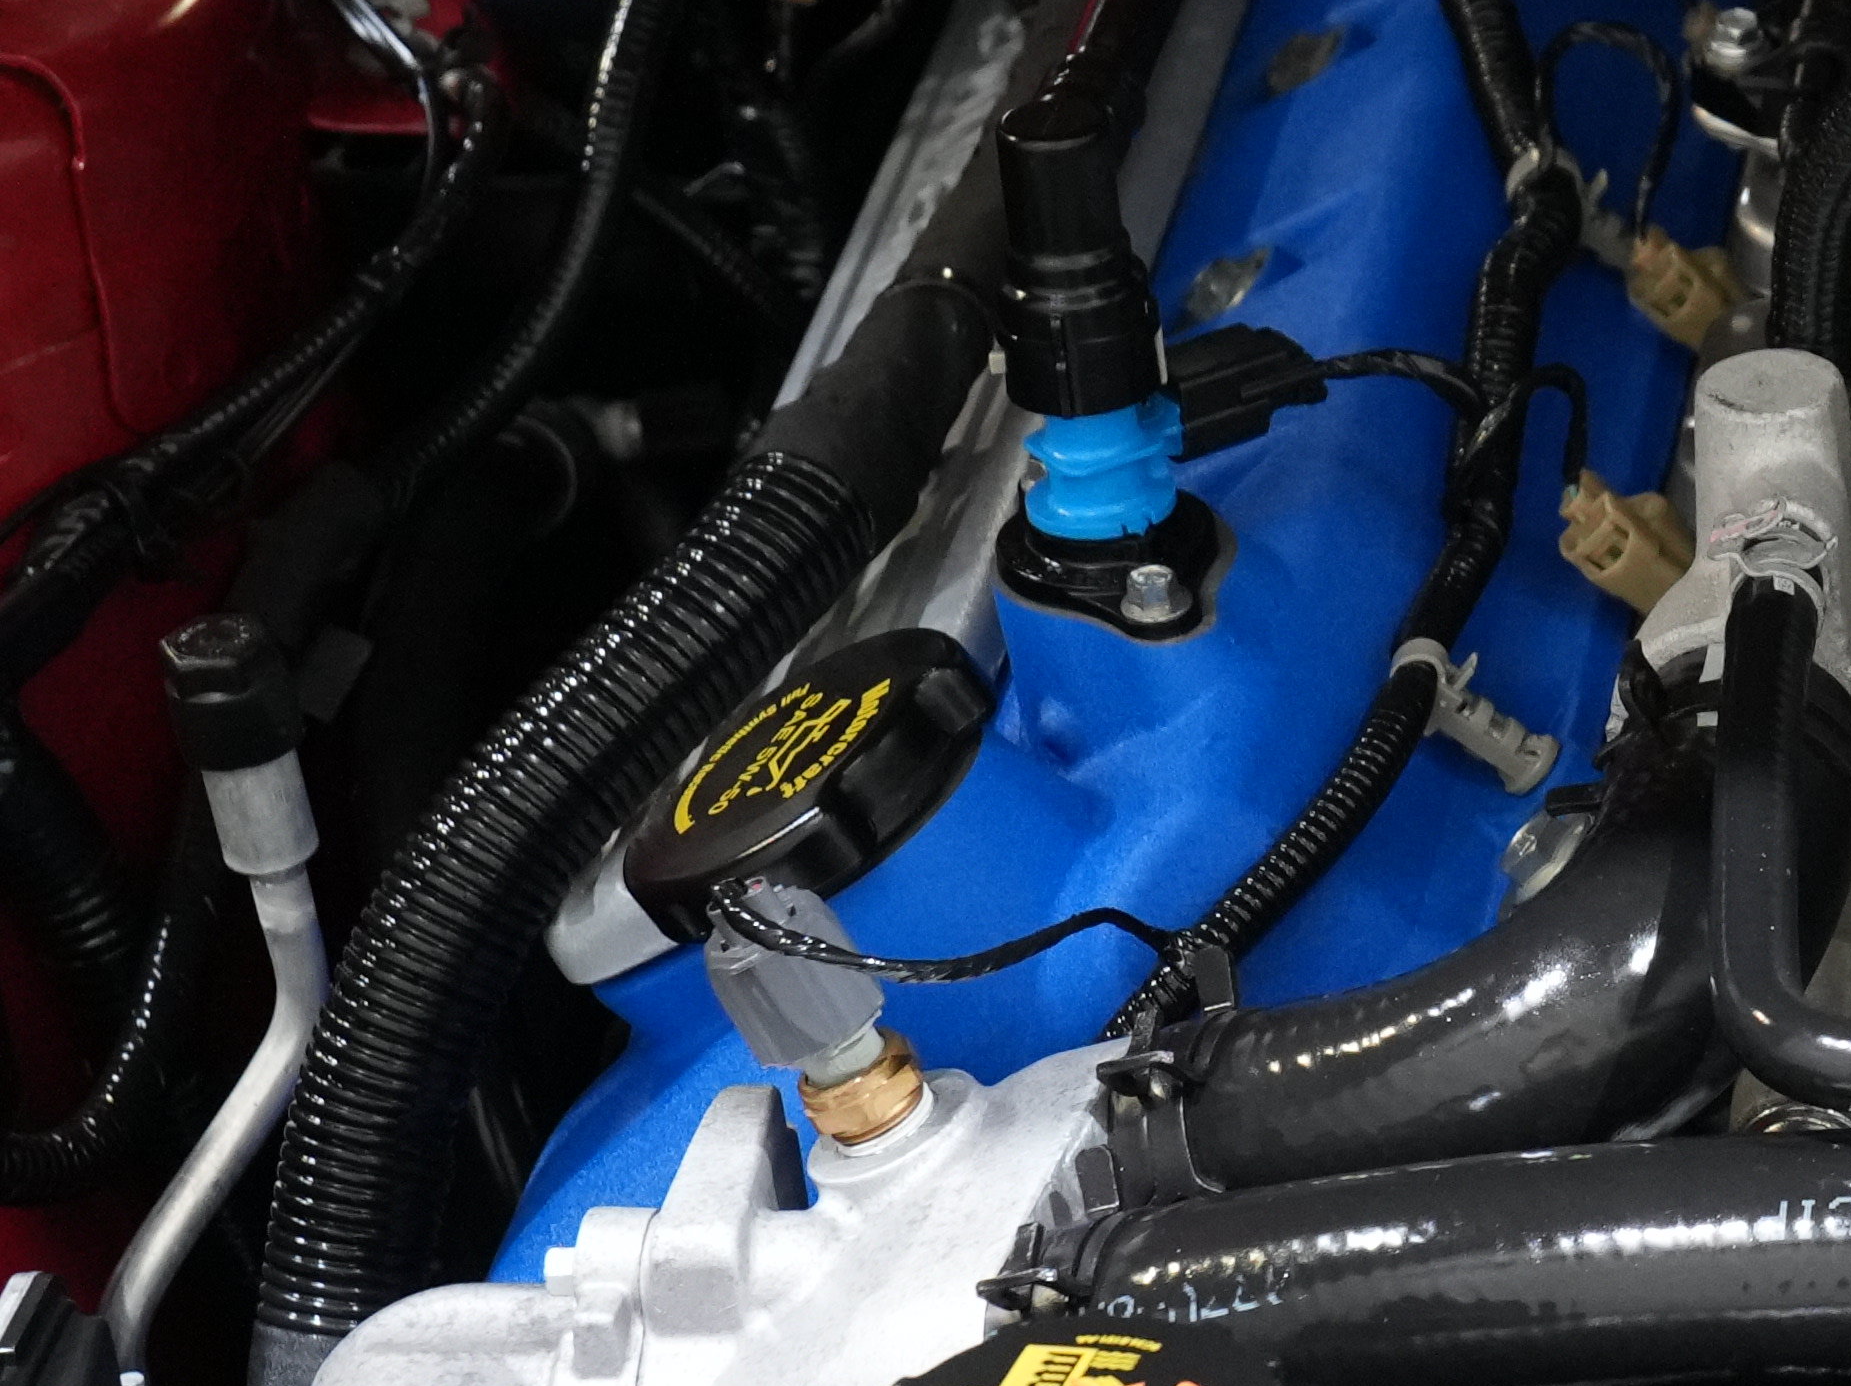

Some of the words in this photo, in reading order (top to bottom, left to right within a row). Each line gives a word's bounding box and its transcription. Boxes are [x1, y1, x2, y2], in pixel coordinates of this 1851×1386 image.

[771, 692, 824, 743] SAE
[779, 678, 891, 799] Motorcraft
[708, 746, 779, 815] 5W-50
